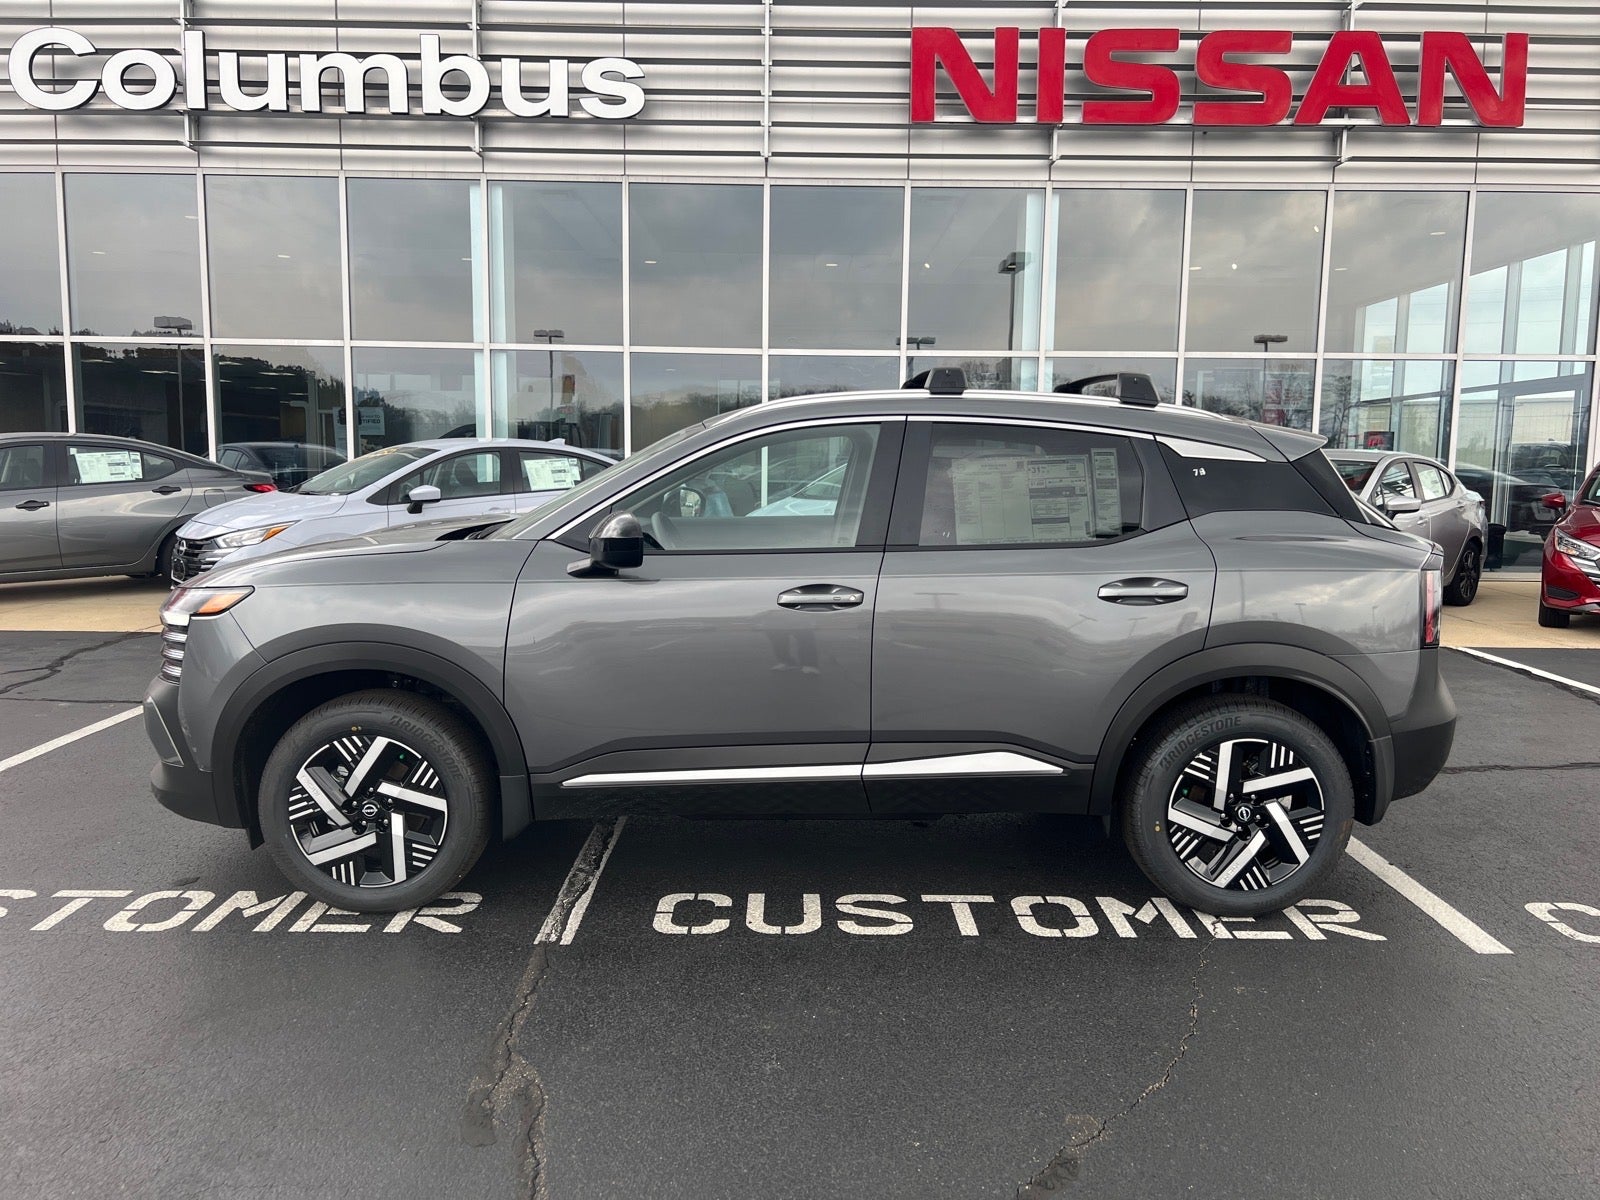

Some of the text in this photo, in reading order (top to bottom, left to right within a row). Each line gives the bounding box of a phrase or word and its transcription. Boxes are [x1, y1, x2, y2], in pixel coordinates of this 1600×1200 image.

[8, 27, 646, 119] Columbus
[910, 27, 1529, 128] NISSAN
[1159, 716, 1242, 772] BRIDGESTONE
[652, 892, 1388, 941] CUSTOMER
